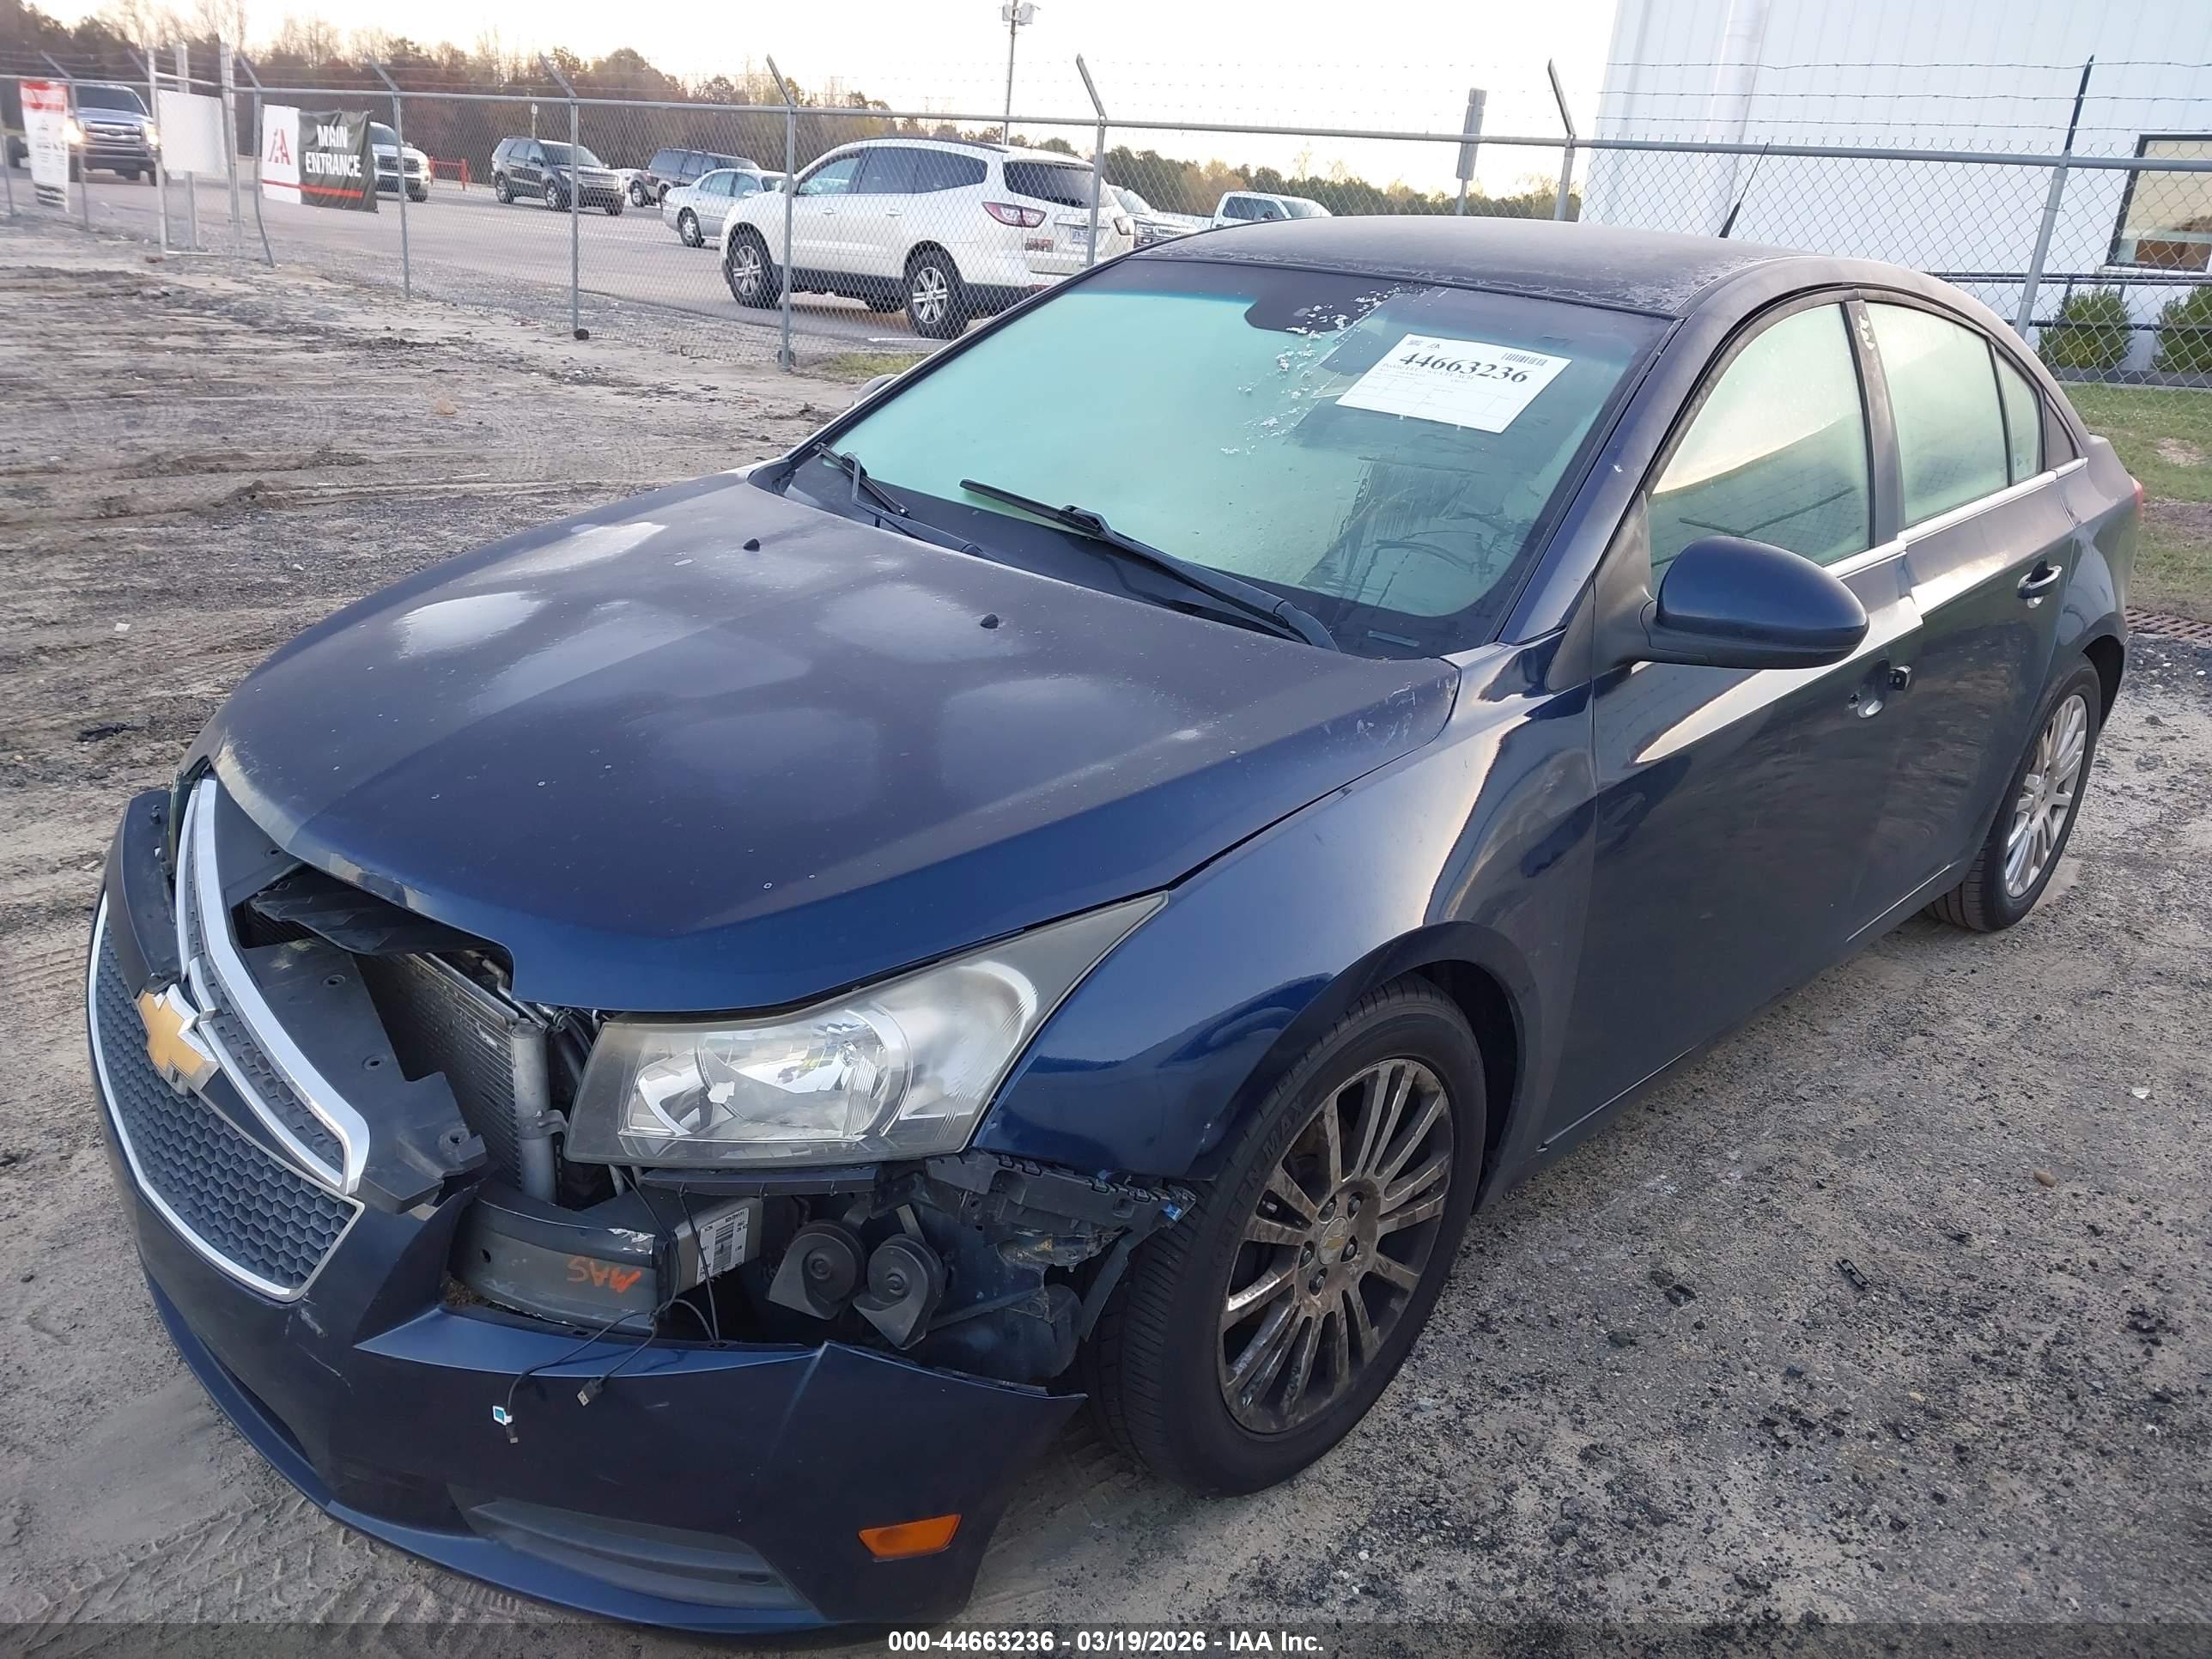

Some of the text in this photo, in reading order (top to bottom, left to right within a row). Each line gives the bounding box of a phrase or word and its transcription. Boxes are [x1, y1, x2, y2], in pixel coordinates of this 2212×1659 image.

[317, 125, 348, 149] MAIN
[305, 151, 362, 178] ENTRANCE
[1399, 352, 1534, 383] 44663236
